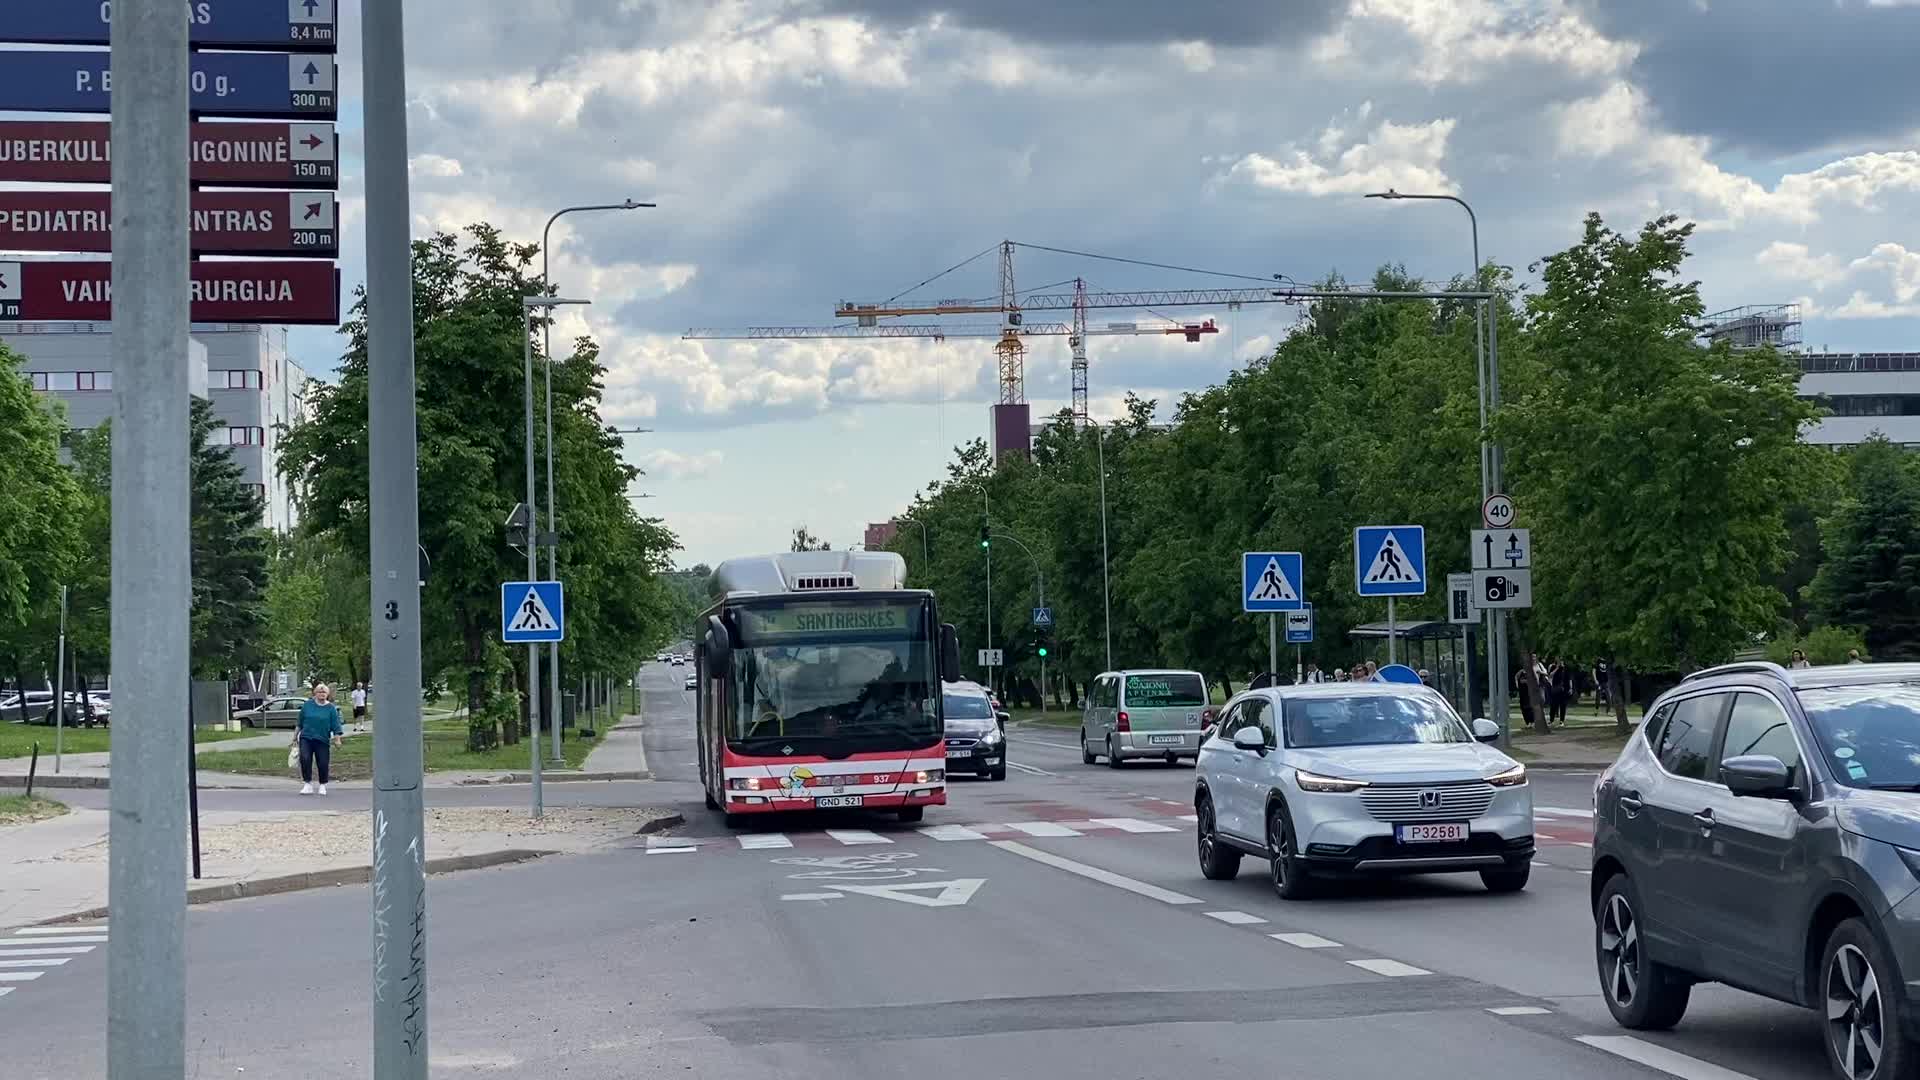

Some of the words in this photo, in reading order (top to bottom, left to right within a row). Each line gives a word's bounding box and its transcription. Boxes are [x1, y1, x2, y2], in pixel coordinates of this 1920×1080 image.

[291, 26, 310, 39] 8,4
[314, 26, 331, 39] km
[76, 70, 92, 91] P.
[215, 75, 236, 97] g.
[293, 94, 315, 106] 300
[319, 96, 330, 106] m
[0, 139, 111, 162] UBERKULI
[187, 136, 288, 163] IGONINĖ
[294, 163, 316, 176] 150
[320, 165, 331, 175] m
[0, 210, 112, 232] PEDIATRI
[187, 210, 273, 232] NTRAS
[293, 232, 316, 244] 200
[320, 234, 331, 244] m
[190, 279, 294, 302] RURGIJA
[7, 304, 19, 316] m
[1490, 504, 1509, 518] 40
[385, 600, 400, 622] 3
[873, 775, 890, 783] 937
[820, 797, 840, 807] GND
[845, 797, 861, 805] 521
[1412, 826, 1460, 839] P32581
